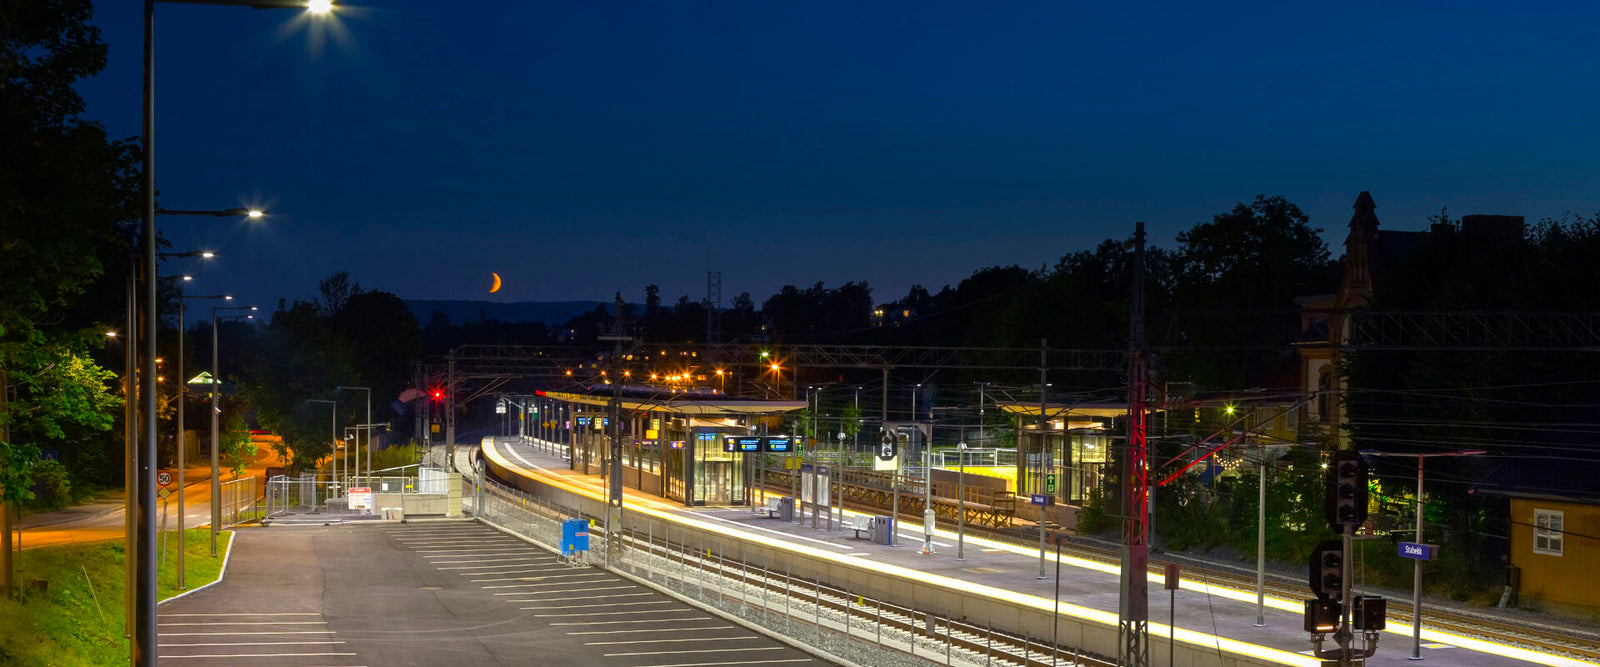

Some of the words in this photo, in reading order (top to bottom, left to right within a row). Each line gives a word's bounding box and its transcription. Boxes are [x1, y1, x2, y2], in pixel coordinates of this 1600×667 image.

[728, 443, 734, 451] 2
[159, 474, 170, 483] 50
[1405, 545, 1422, 555] Stabekk
